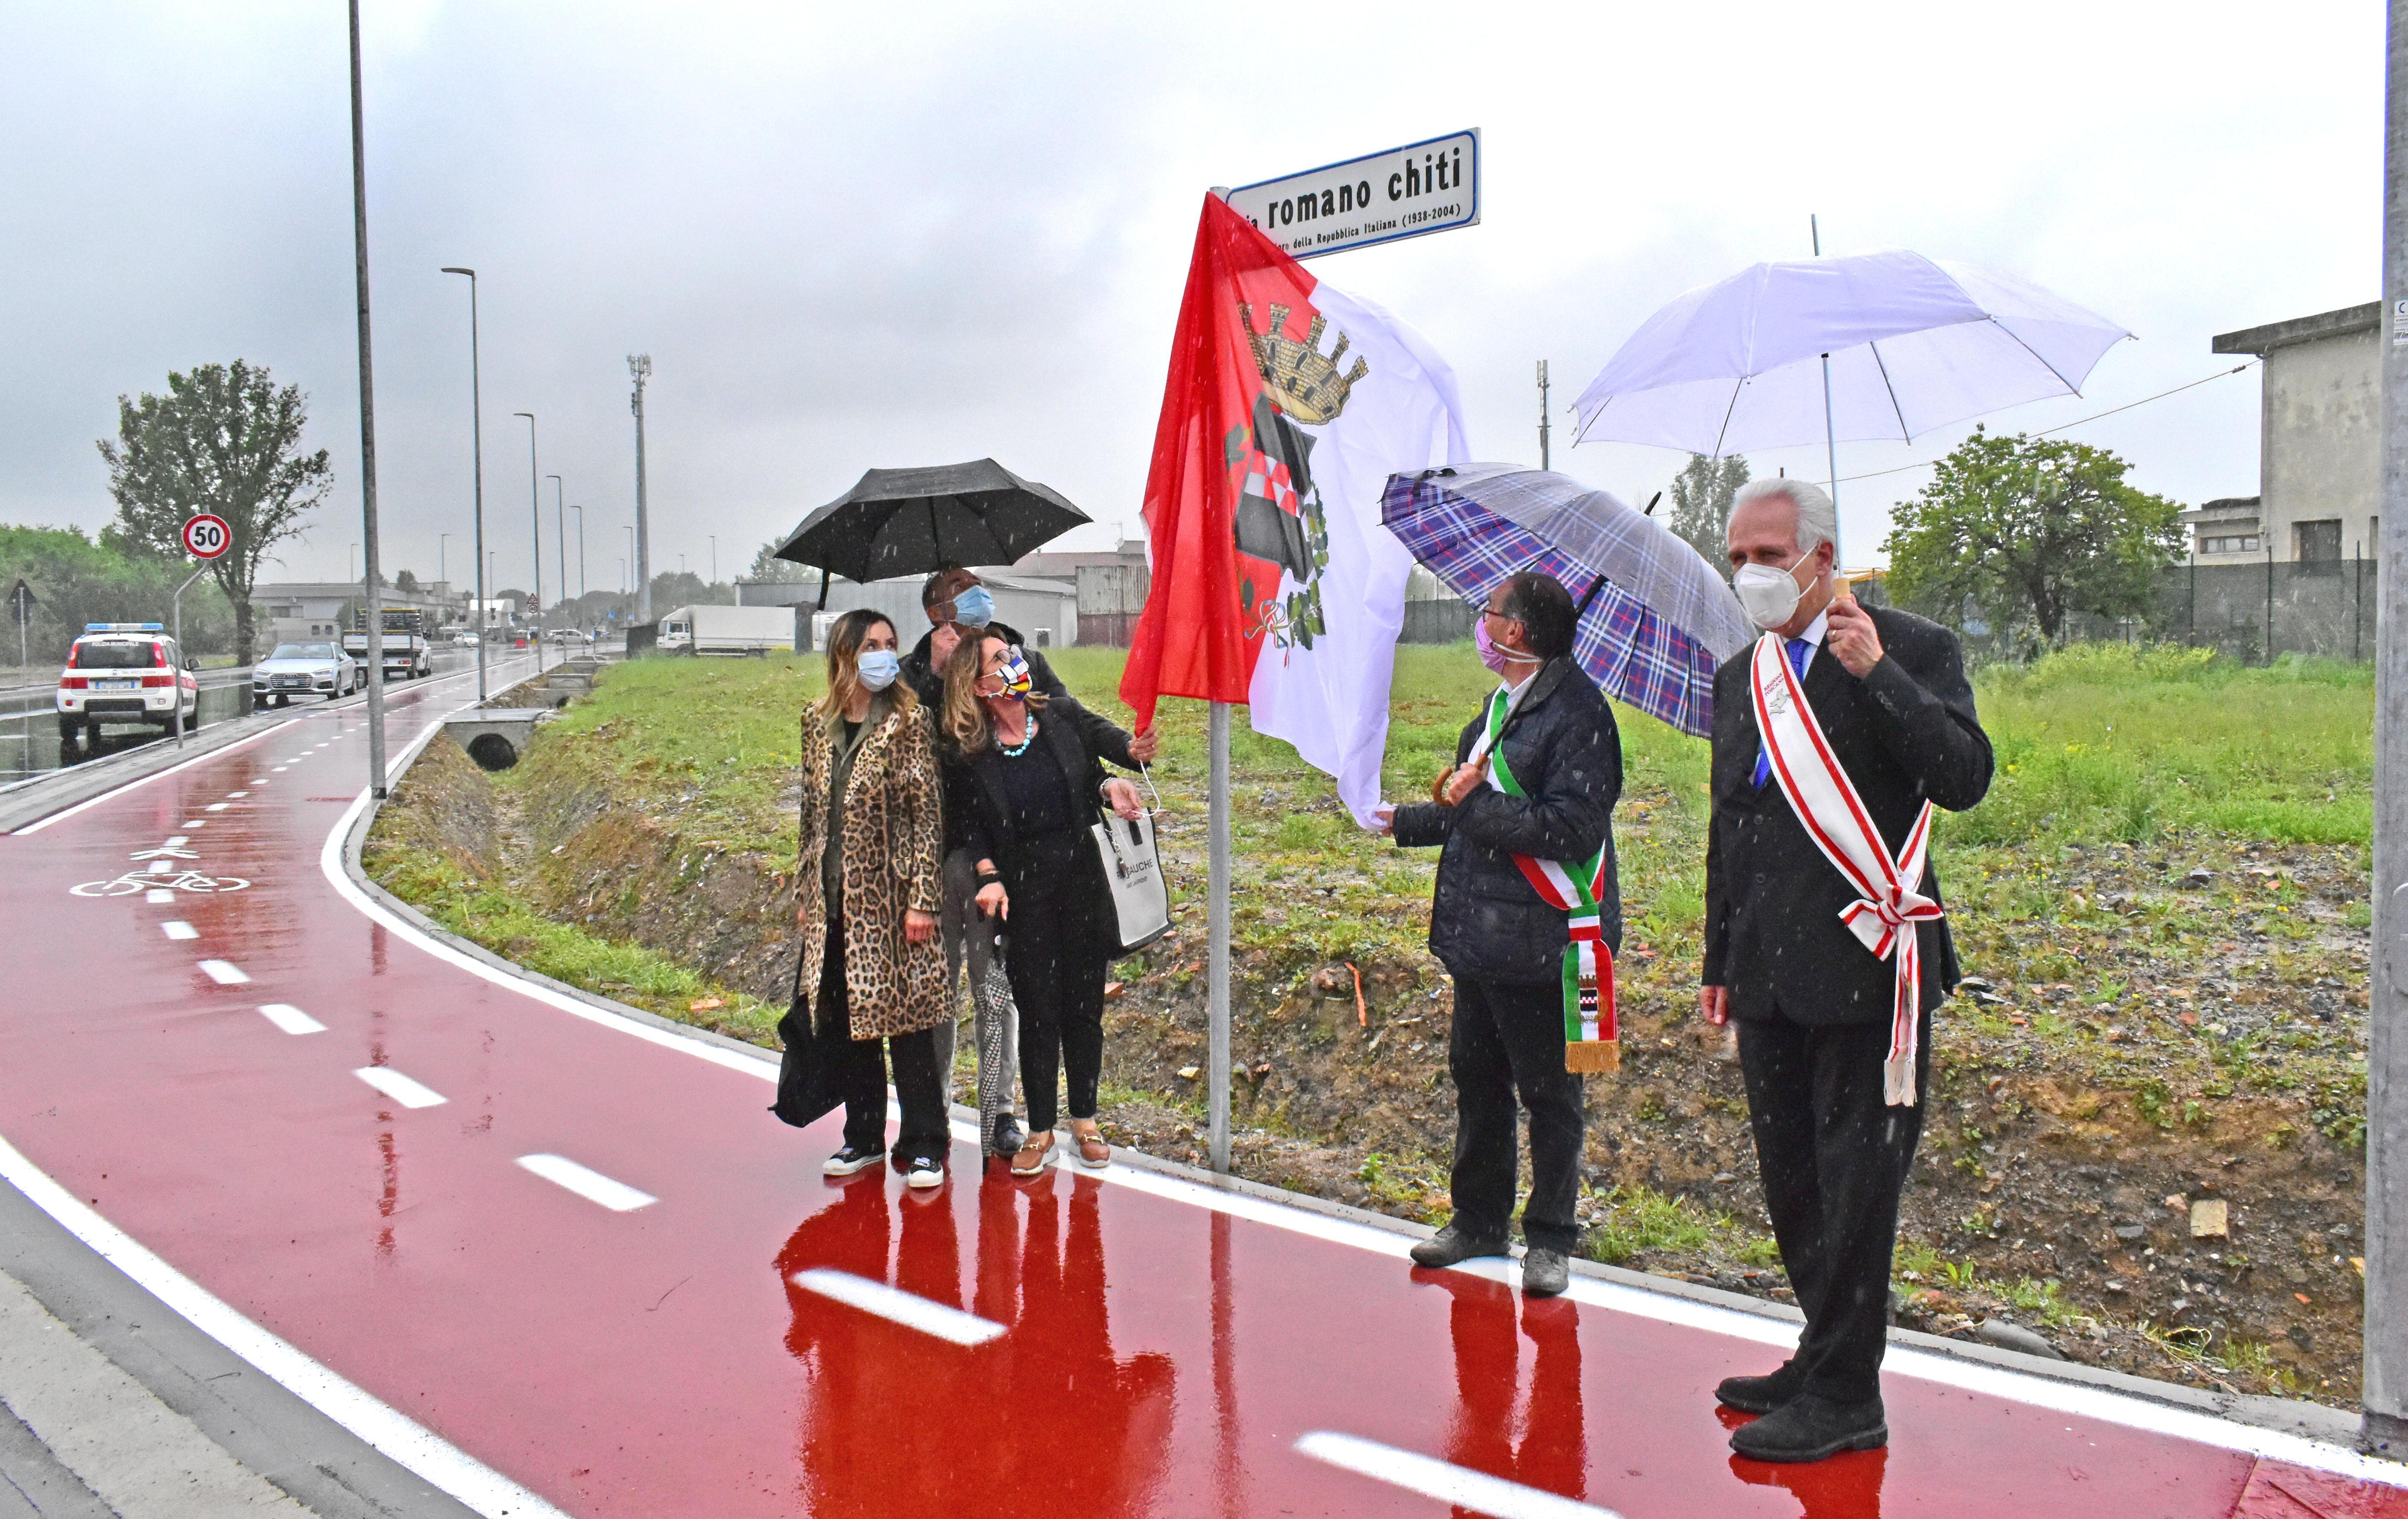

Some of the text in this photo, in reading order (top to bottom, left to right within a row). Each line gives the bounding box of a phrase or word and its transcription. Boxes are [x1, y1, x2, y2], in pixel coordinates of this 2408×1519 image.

[1269, 180, 1371, 229] romano
[1388, 147, 1460, 201] chiti
[1293, 237, 1312, 248] della
[1317, 227, 1359, 244] Repubblica
[1364, 220, 1397, 234] Italiana
[1402, 203, 1461, 227] (1938-2004)
[194, 526, 220, 547] 50
